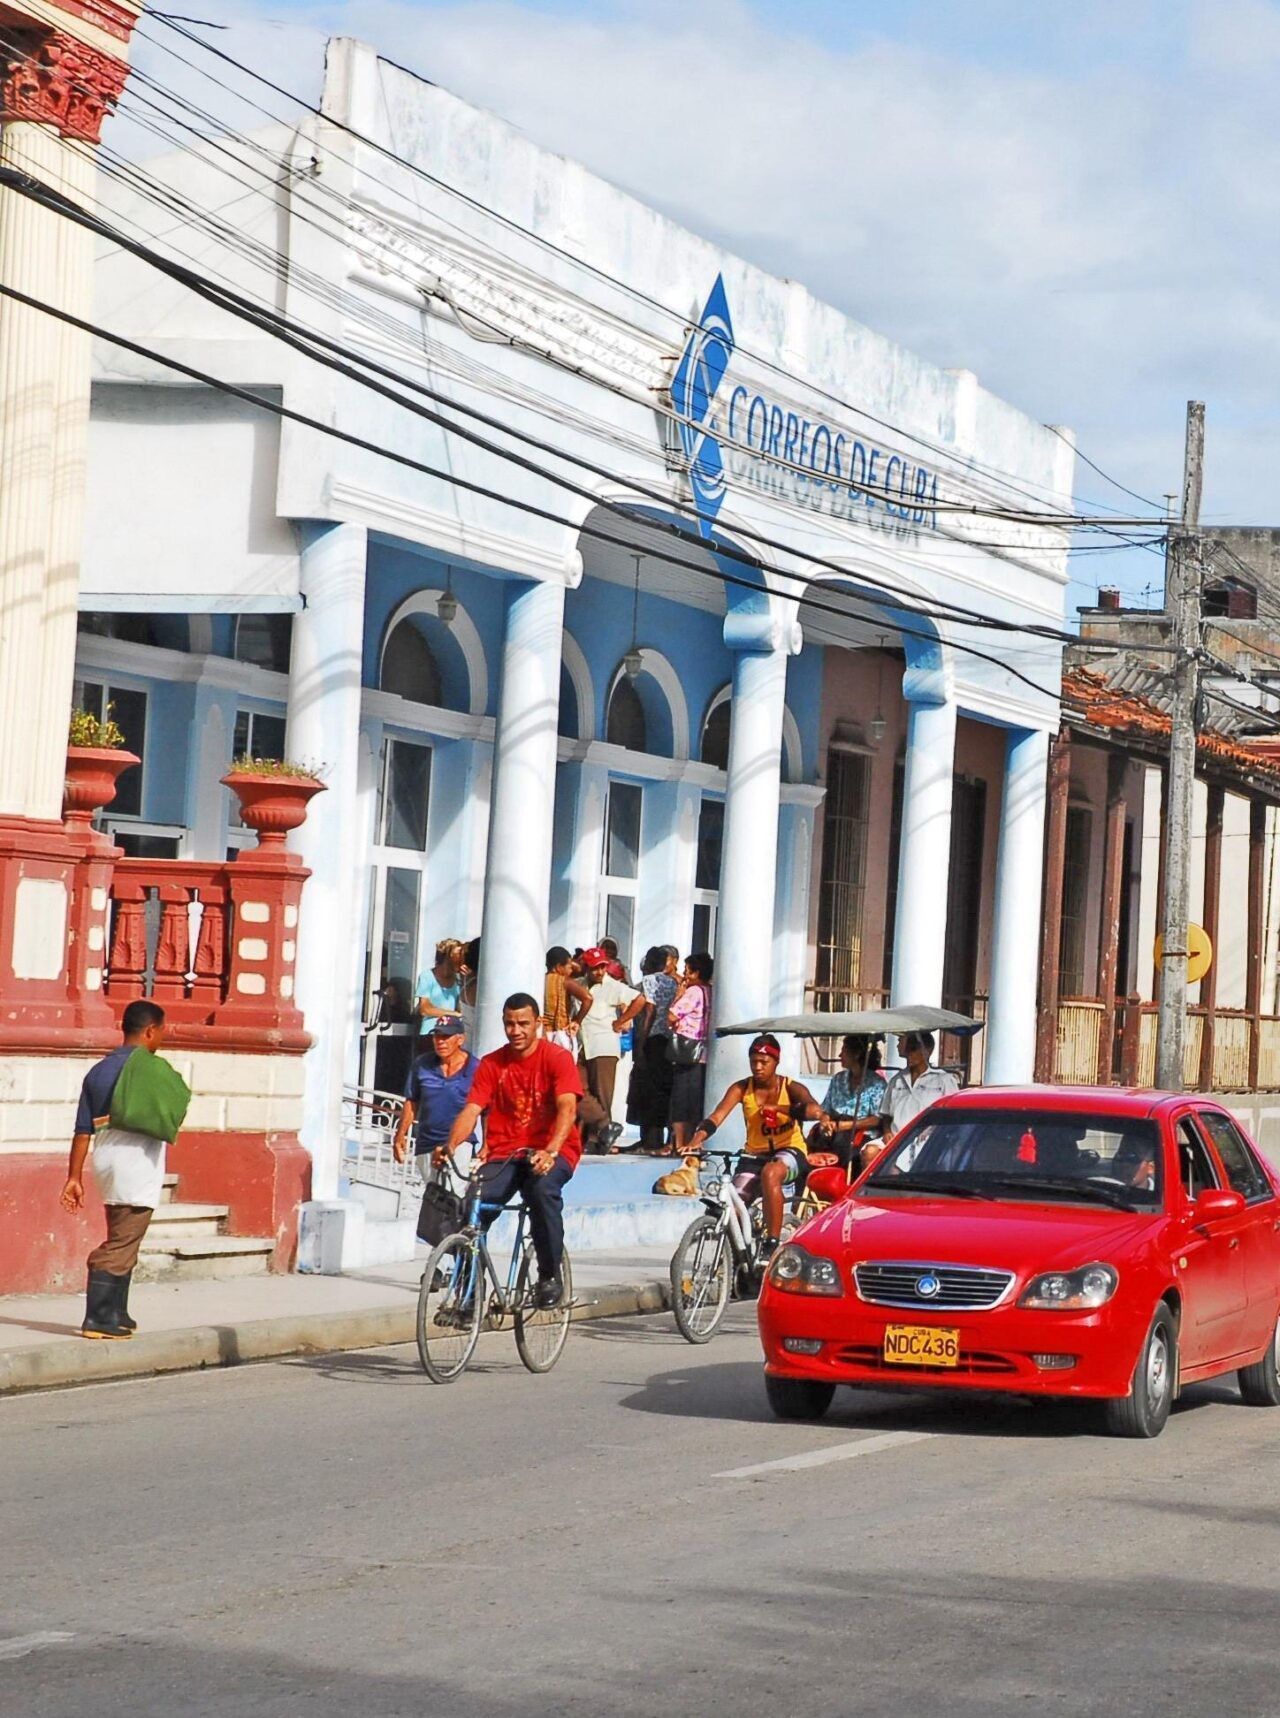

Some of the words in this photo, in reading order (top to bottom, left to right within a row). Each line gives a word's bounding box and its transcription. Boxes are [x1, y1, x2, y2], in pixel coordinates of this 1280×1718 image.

[729, 386, 846, 493] CORREOS
[848, 441, 880, 507] DE
[885, 455, 938, 530] CUBA
[886, 1334, 956, 1357] NDC436
